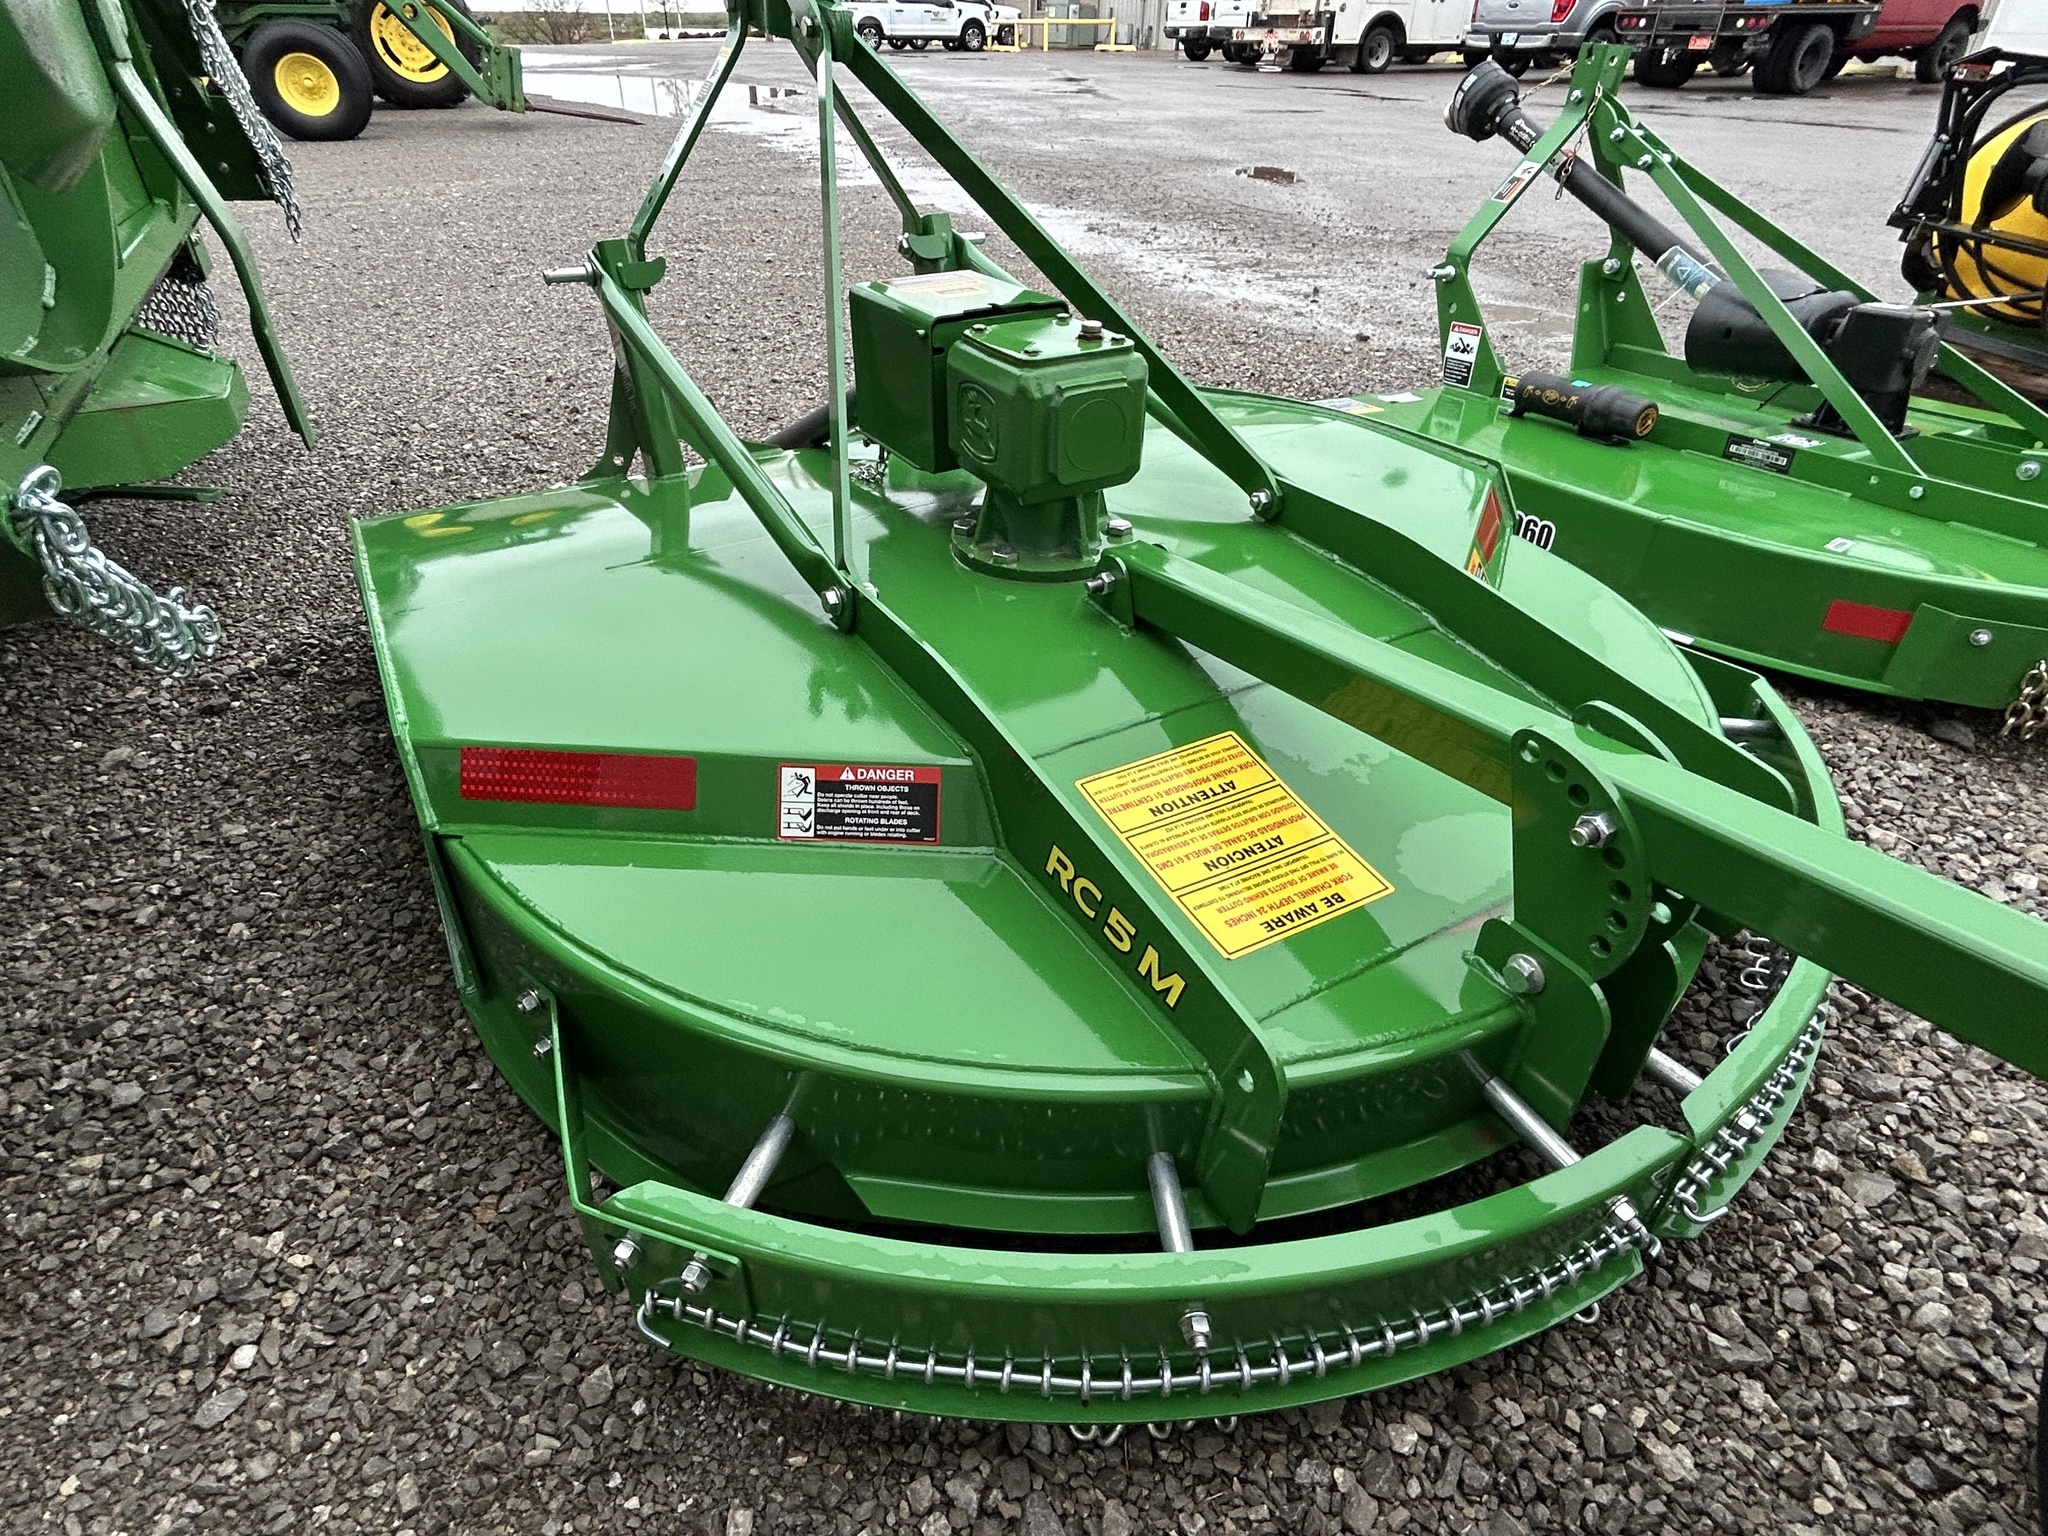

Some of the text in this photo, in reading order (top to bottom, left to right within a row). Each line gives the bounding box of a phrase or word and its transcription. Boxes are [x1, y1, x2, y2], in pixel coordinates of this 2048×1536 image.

[1225, 750, 1246, 760] SOYEZ
[1193, 756, 1228, 771] CONSCIENT
[1235, 759, 1257, 770] FORK
[857, 768, 914, 781] DANGER
[1159, 771, 1184, 782] OBJETS
[1181, 767, 1196, 775] DES
[1161, 774, 1212, 795] PROFONDEUR
[1097, 791, 1123, 803] CUTTER
[1147, 779, 1240, 817] ATTENTION
[1151, 790, 1164, 799] 61
[1269, 801, 1297, 814] CUIDADO
[844, 816, 878, 824] ROTATING
[1256, 810, 1272, 819] CON
[1229, 815, 1258, 829] OBJETOS
[1153, 811, 1307, 871] PROFUNDIDAD DE CANAL DE MUELA 61 CMS
[1201, 834, 1287, 872] ATENCIÓN
[1214, 861, 1339, 914] BE AWARE OF OBJECTS BEHIND CUTTER
[1223, 871, 1354, 928] FORK CHANNEL DEPTH 24 INCHES
[1258, 891, 1346, 933] BE AWARE
